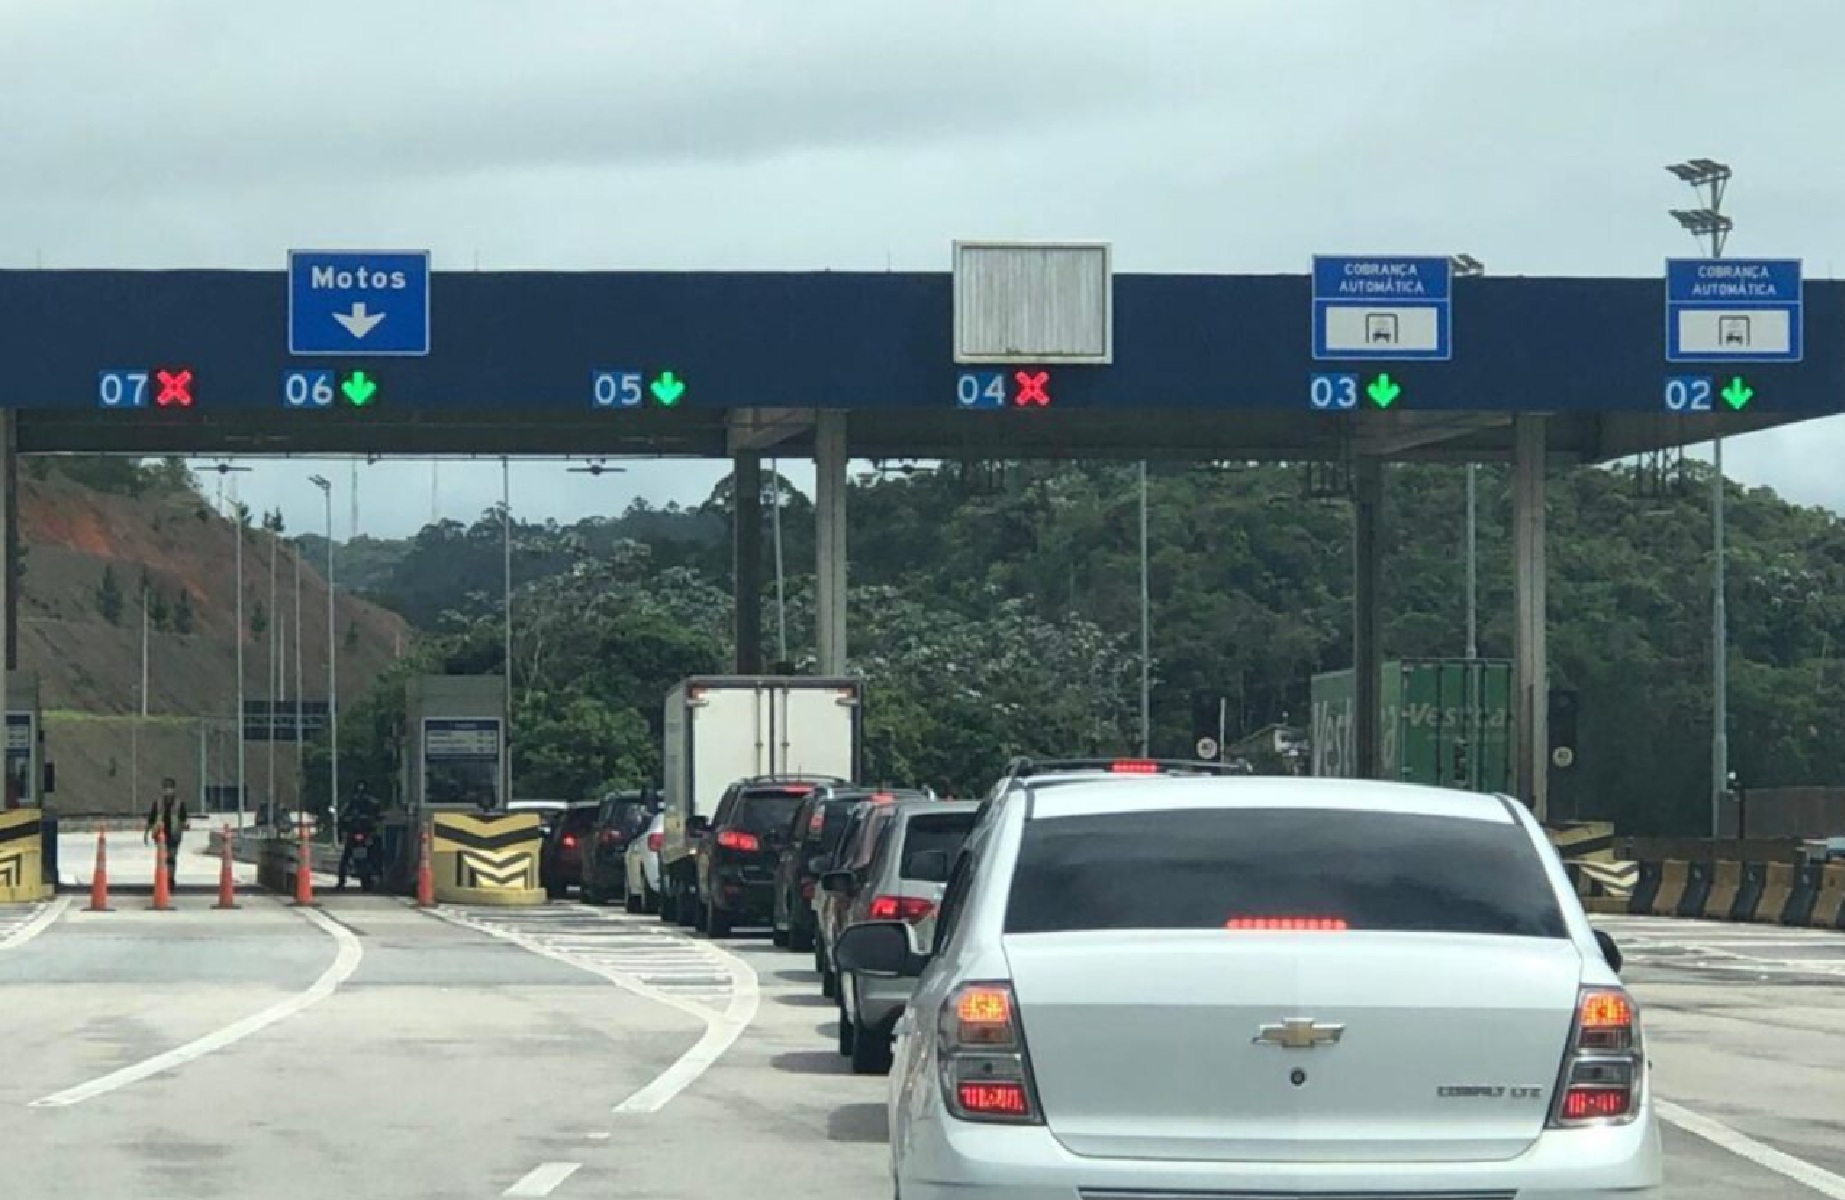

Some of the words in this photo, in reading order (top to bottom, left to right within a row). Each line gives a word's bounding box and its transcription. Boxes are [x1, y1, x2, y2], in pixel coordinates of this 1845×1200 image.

[311, 265, 406, 289] Motos
[1339, 277, 1425, 293] AUTOMÁTICA
[1343, 263, 1419, 278] COBRANÇA
[1697, 265, 1769, 279] COBRANÇA
[1691, 280, 1777, 295] AUTOMÁTICA
[101, 373, 148, 405] 07
[286, 373, 333, 405] 06
[594, 373, 642, 405] 05
[958, 373, 1006, 406] 04
[1311, 376, 1357, 407] 03
[1665, 379, 1712, 410] 02
